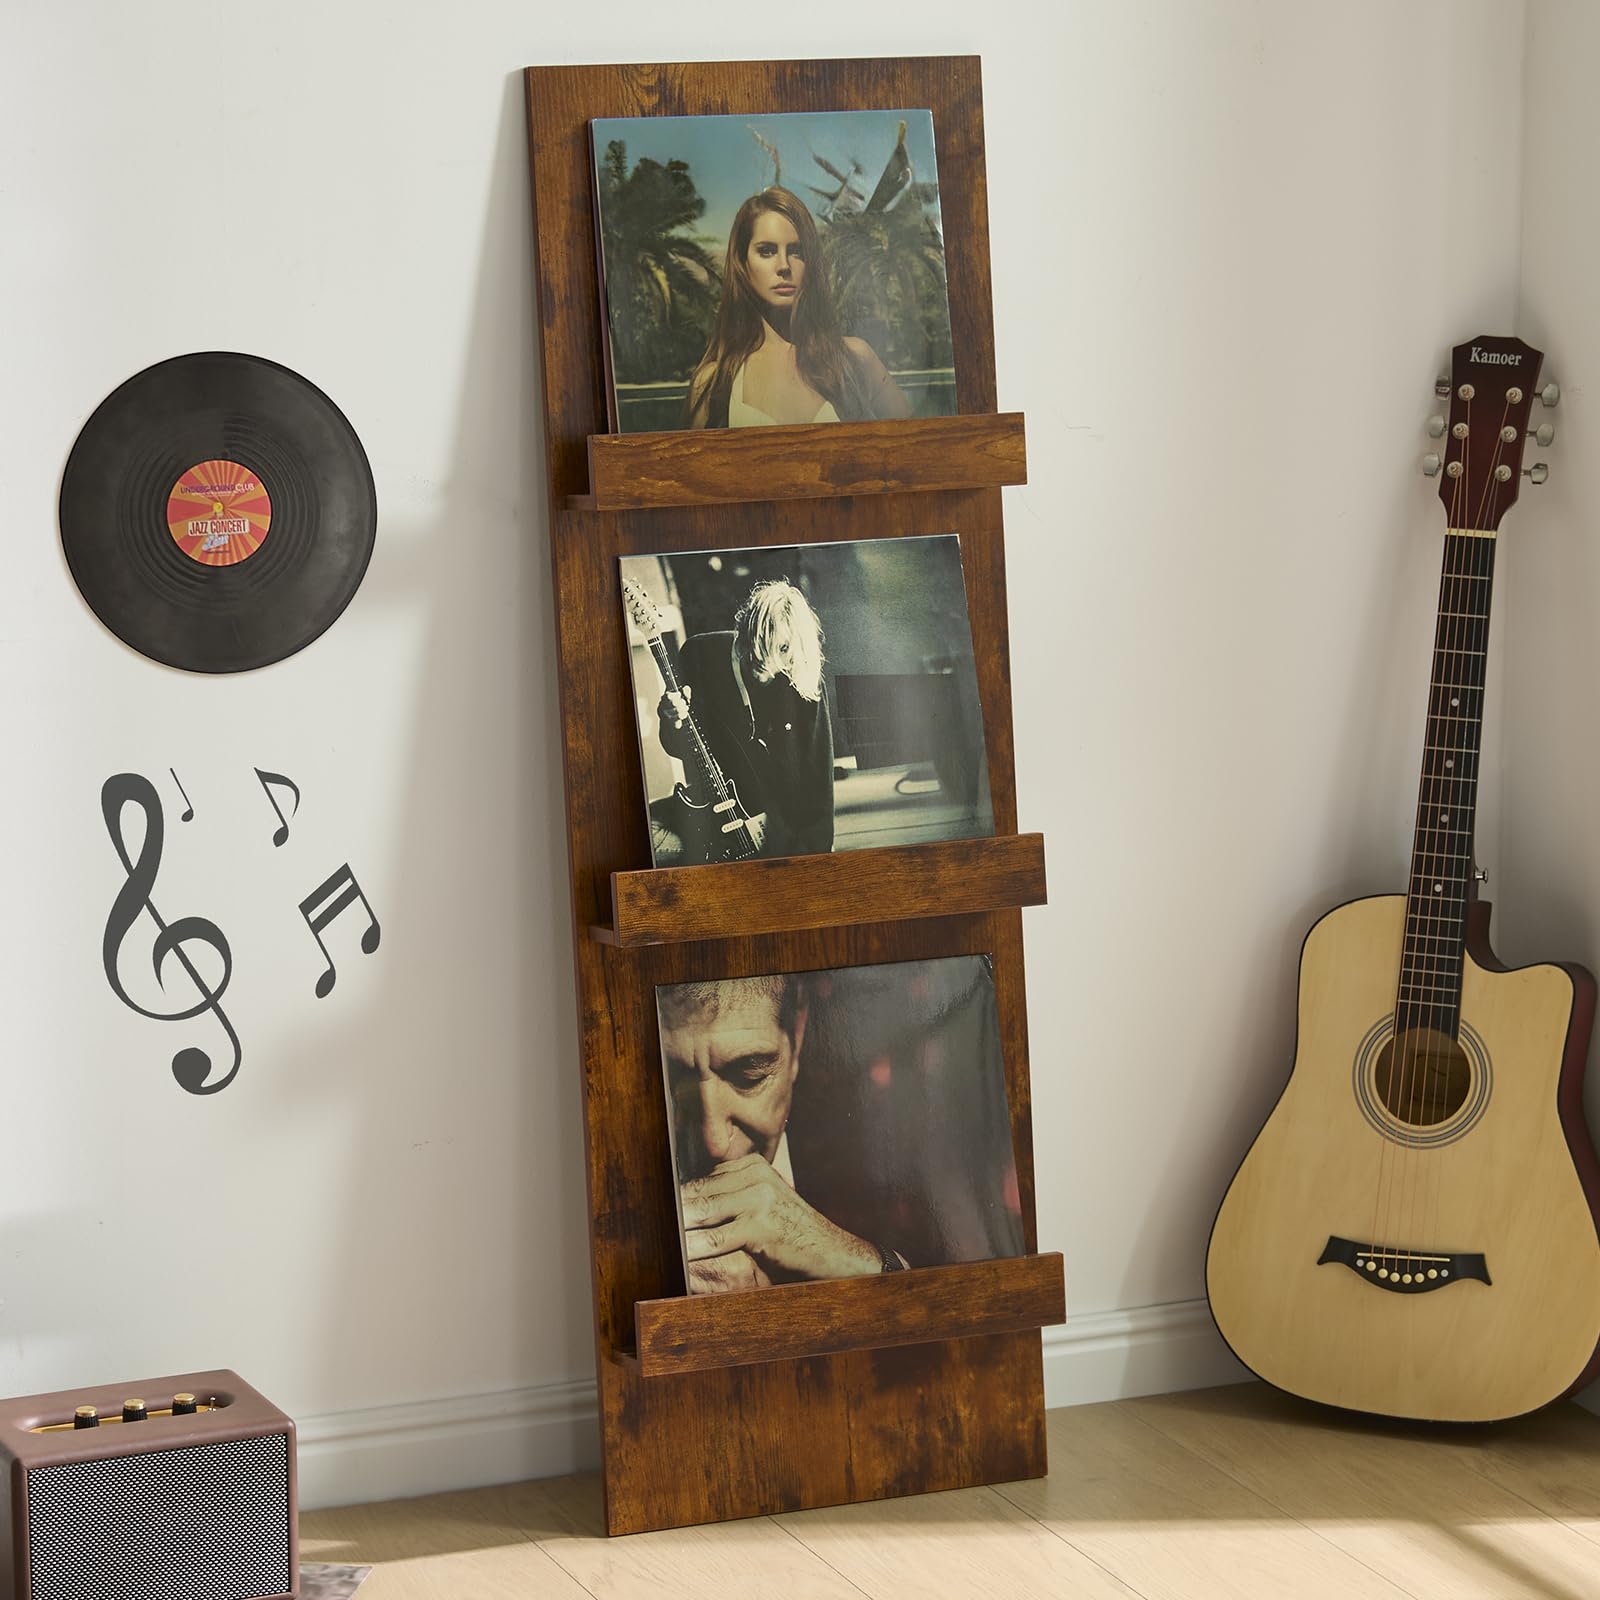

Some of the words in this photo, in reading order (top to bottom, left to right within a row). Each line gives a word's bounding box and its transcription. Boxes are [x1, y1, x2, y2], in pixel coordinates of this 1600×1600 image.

[1470, 346, 1522, 366] Kamoer
[189, 520, 209, 535] JAZZ
[210, 519, 247, 534] CONCERT
